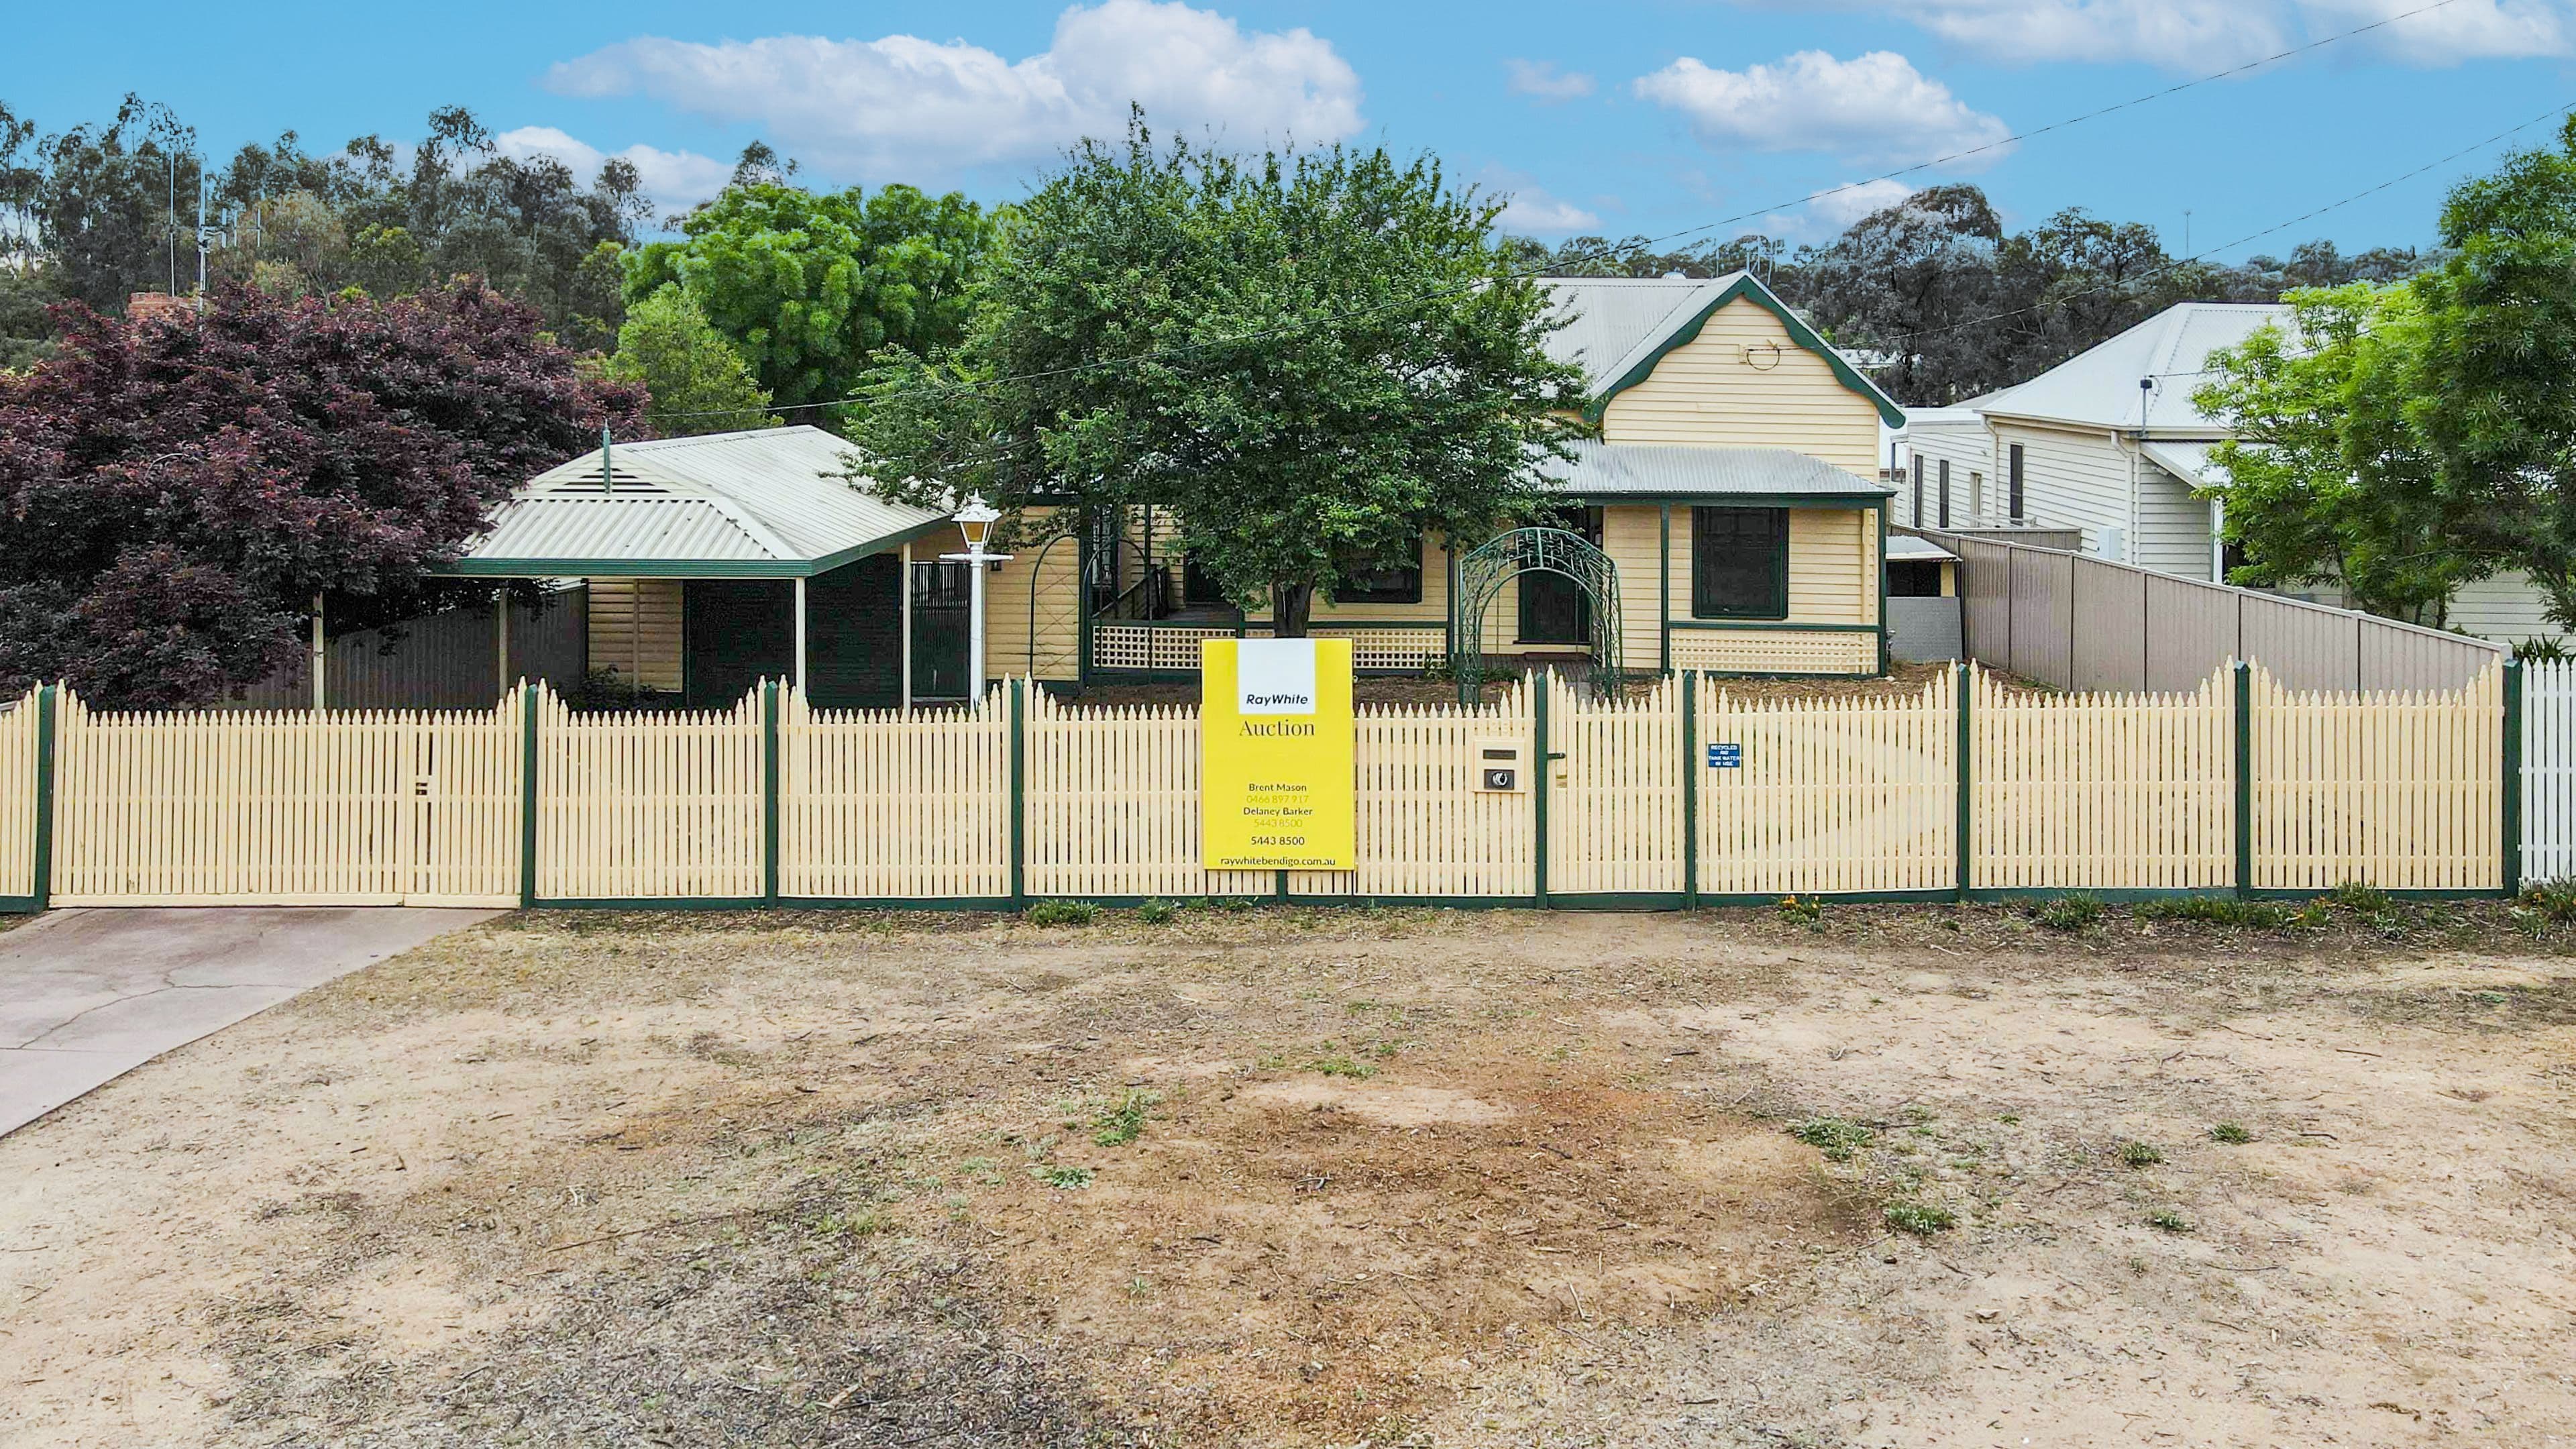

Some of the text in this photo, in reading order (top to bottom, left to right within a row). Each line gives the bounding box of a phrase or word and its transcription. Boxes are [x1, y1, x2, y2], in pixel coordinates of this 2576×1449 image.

[1240, 719, 1315, 737] Auction
[1249, 784, 1307, 792] Brent Mason
[1246, 795, 1309, 804] 0466 897 917
[1243, 807, 1313, 816] Delaney Barker
[1279, 819, 1303, 828] 8500
[1251, 837, 1305, 845] 5443 8500
[1220, 856, 1336, 867] raywhitebendigo.com.au
